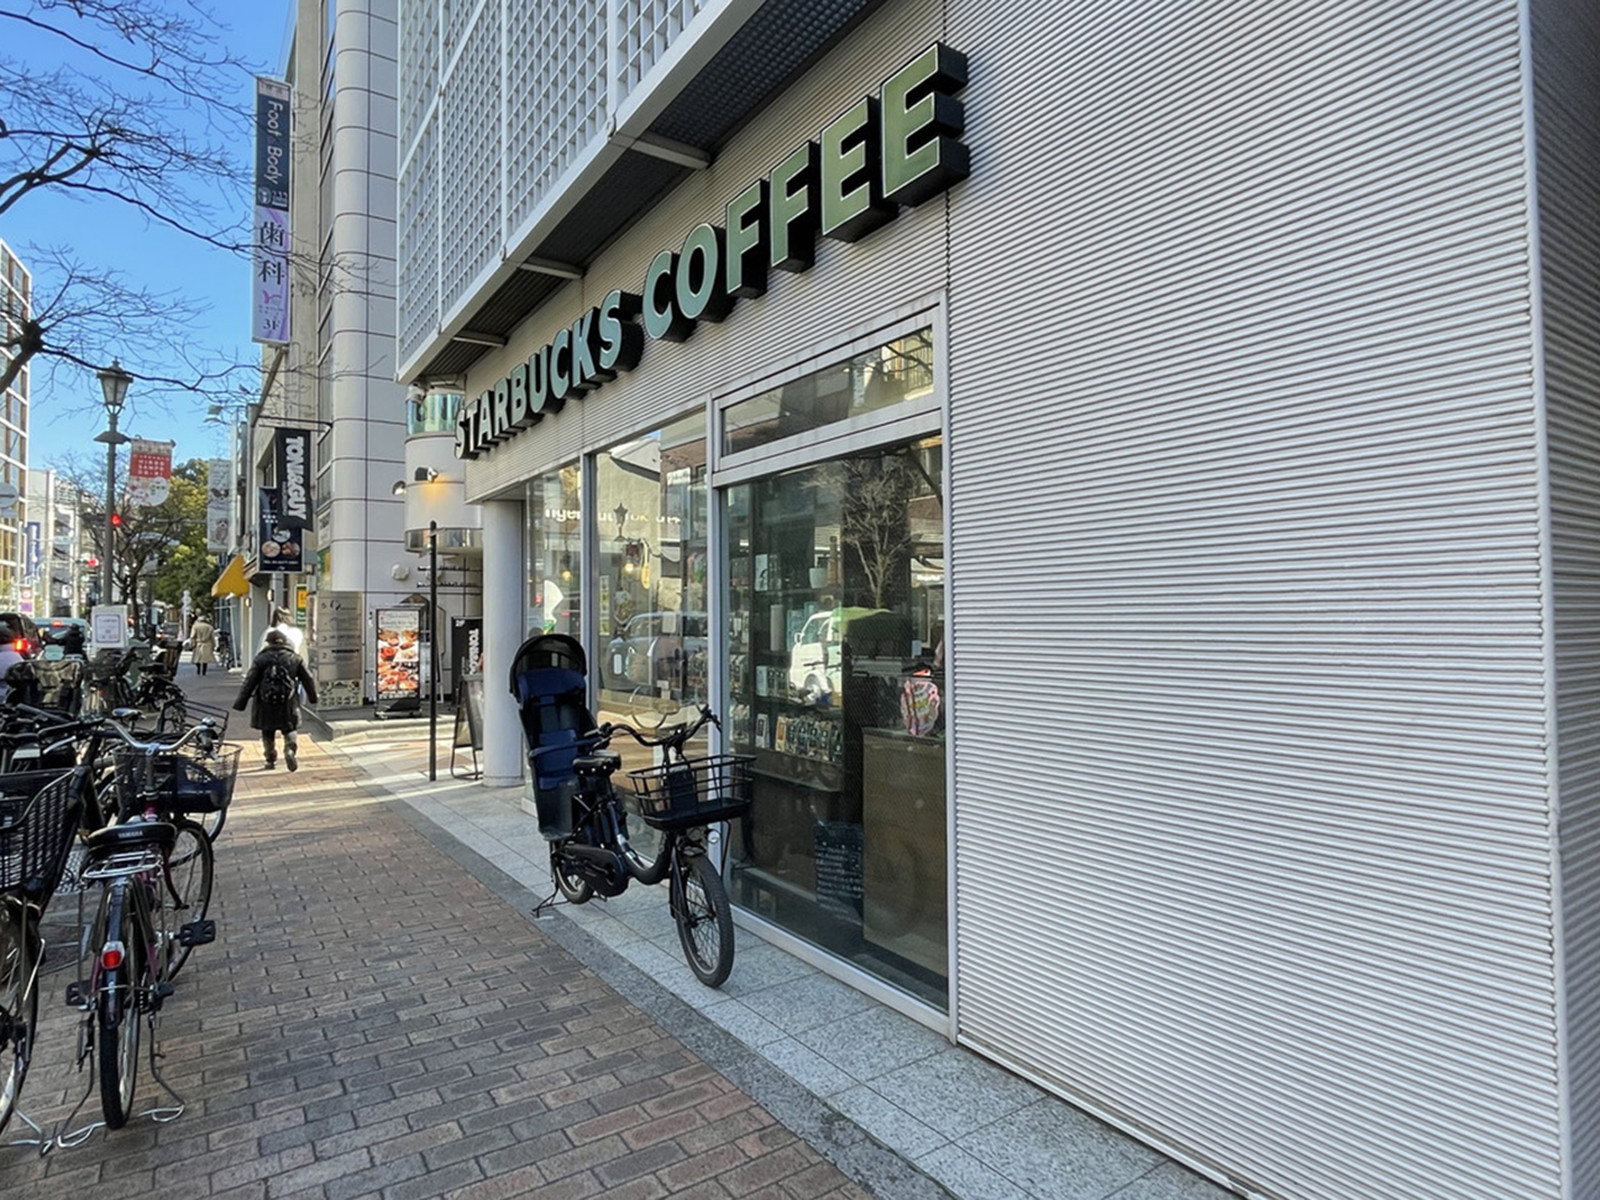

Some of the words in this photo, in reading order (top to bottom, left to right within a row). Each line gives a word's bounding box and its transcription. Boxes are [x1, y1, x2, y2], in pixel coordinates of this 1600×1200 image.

[267, 101, 283, 137] Foot
[264, 145, 283, 185] Body
[258, 221, 285, 286] 歯科
[453, 288, 624, 459] STARBUCKS
[641, 42, 941, 342] COFFEE
[285, 436, 307, 521] TONI&GUY
[468, 628, 480, 675] TONI&G
